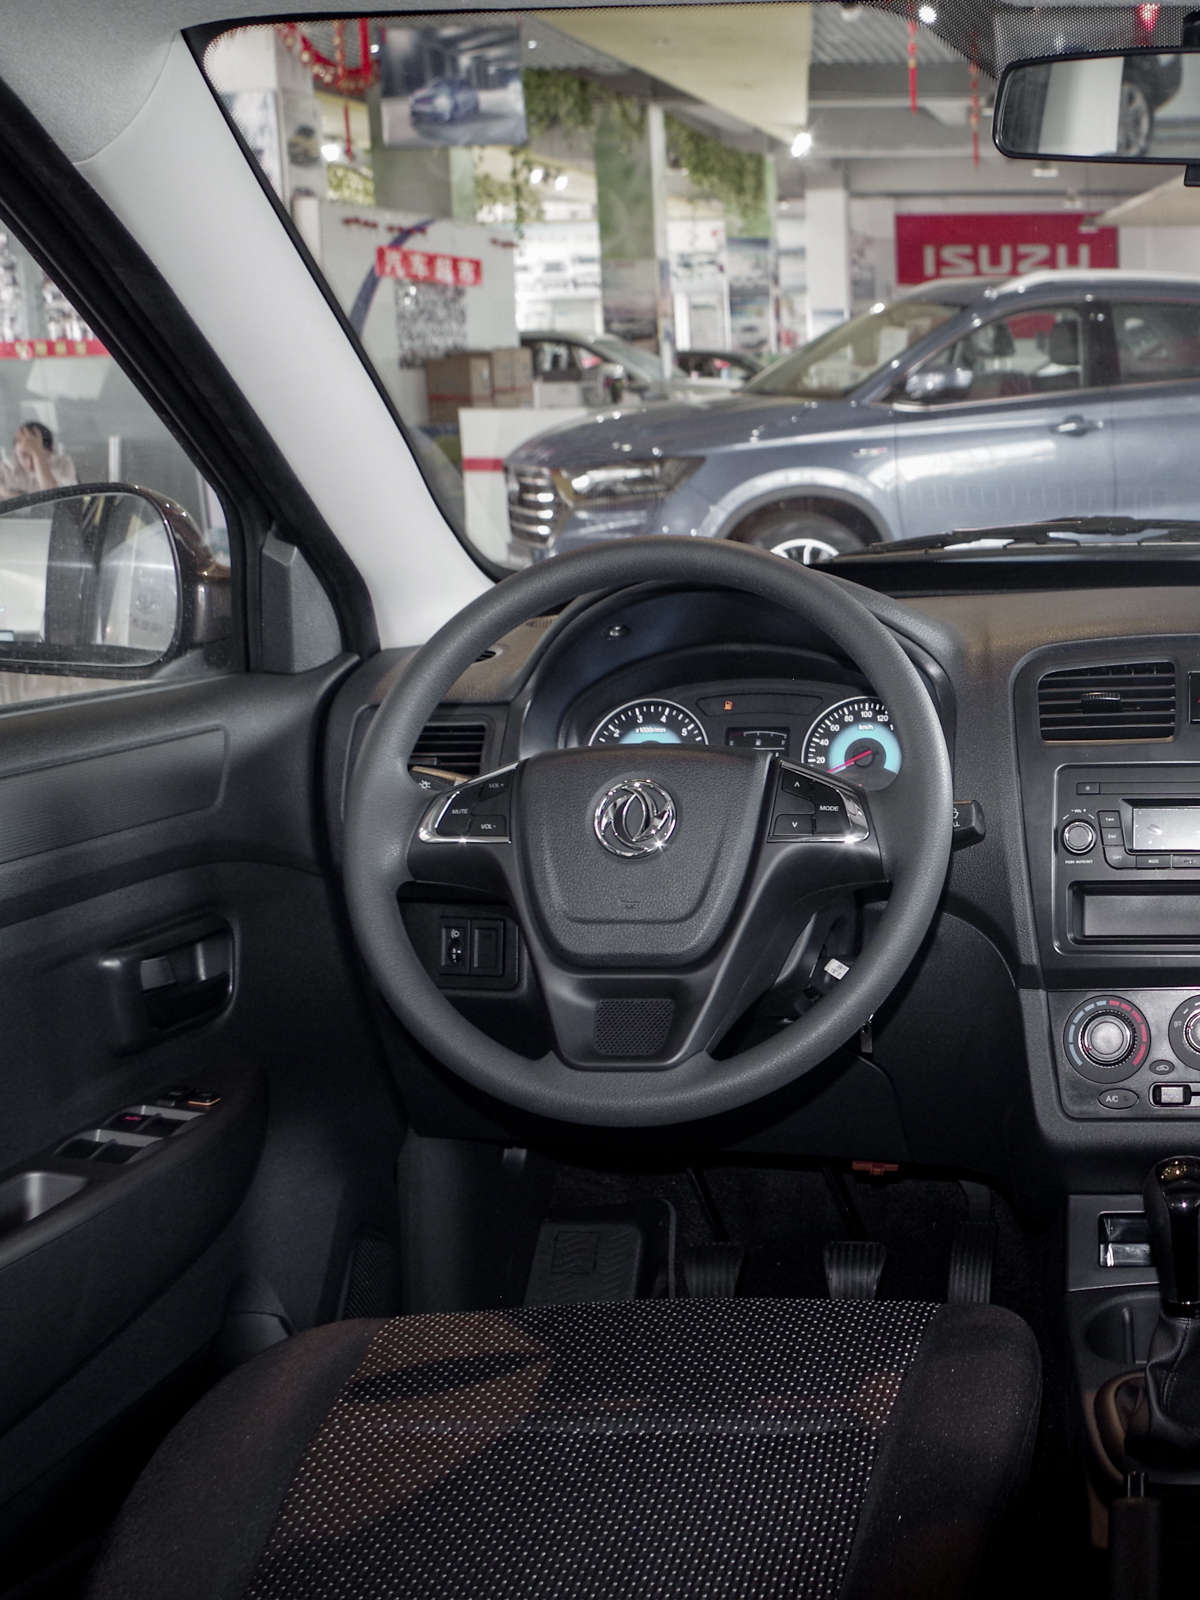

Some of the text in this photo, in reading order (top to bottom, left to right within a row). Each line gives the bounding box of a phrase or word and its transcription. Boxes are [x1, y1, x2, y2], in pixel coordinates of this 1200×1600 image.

[923, 243, 1091, 278] ISUZU
[636, 715, 643, 723] 3
[660, 714, 667, 723] 4
[877, 714, 889, 722] 120
[830, 724, 840, 732] 60
[613, 729, 620, 737] 2
[1105, 1095, 1119, 1103] A/C
